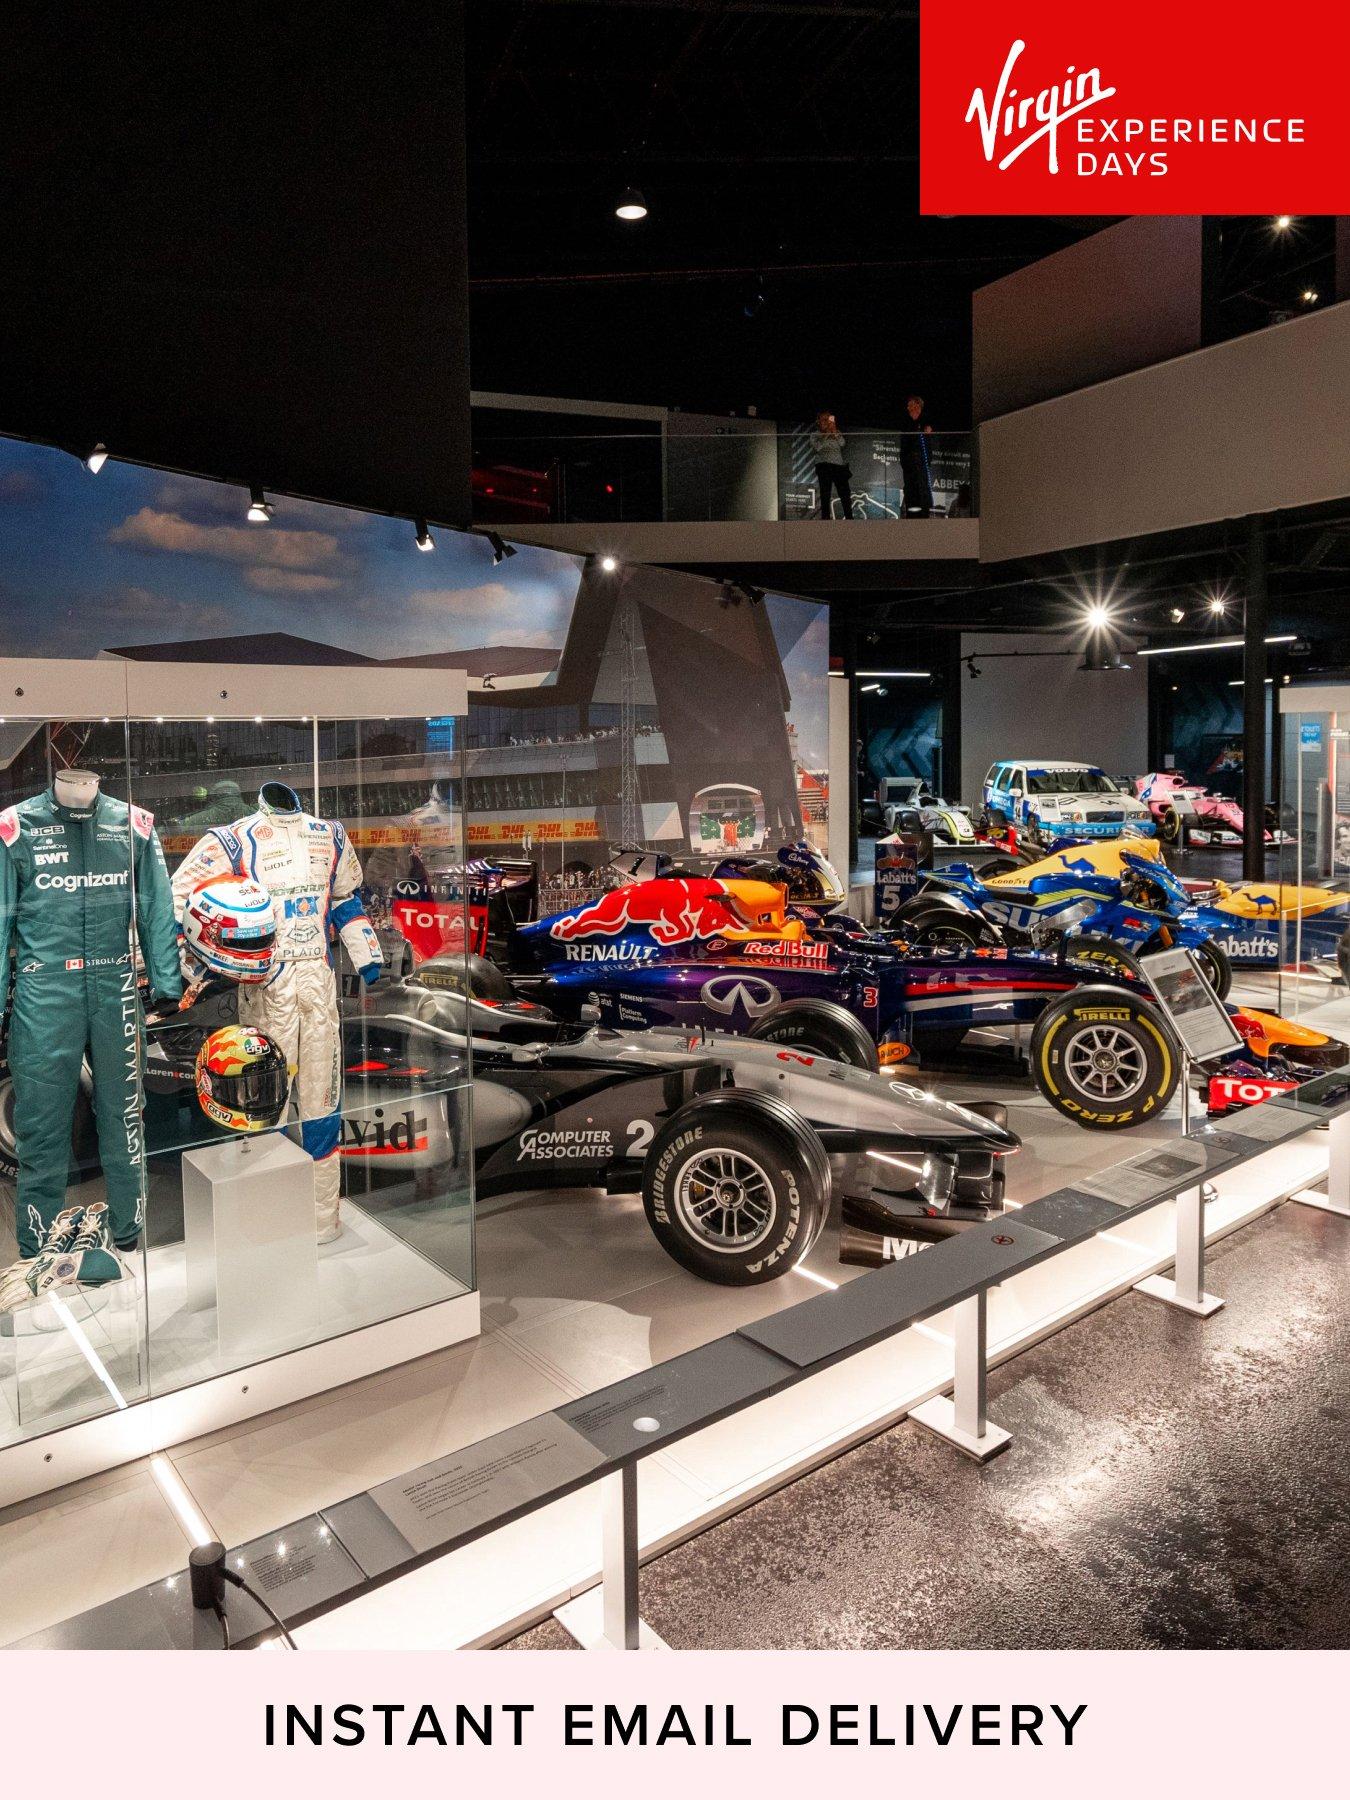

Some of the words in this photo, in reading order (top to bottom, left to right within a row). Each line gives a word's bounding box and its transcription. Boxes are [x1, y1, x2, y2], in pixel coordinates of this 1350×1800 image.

[33, 826, 64, 836] JCB
[34, 852, 69, 866] BWT
[35, 870, 129, 892] Cognizant
[876, 871, 917, 884] Labatt's
[424, 885, 487, 896] INFINITI
[881, 886, 900, 911] 5
[400, 907, 480, 931] TOTAL
[283, 947, 321, 958] PLATO
[565, 944, 658, 961] RENAULT
[743, 941, 785, 956] Red
[786, 939, 830, 959] Bull
[1218, 935, 1279, 958] abatt's
[86, 957, 116, 967] STROLL
[620, 993, 643, 1002] SIEMENS
[863, 987, 878, 1008] 3
[1074, 1007, 1130, 1021] PIRELLI
[207, 1104, 231, 1122] agv
[1060, 1098, 1134, 1124] ZERO
[1142, 1095, 1155, 1113] P
[519, 1129, 611, 1149] COMPUTER
[626, 1119, 655, 1157] 2
[516, 1143, 615, 1162] ASSOCIATES
[654, 1126, 704, 1225] BRIDGESTONE
[746, 1168, 801, 1274] POTENZA
